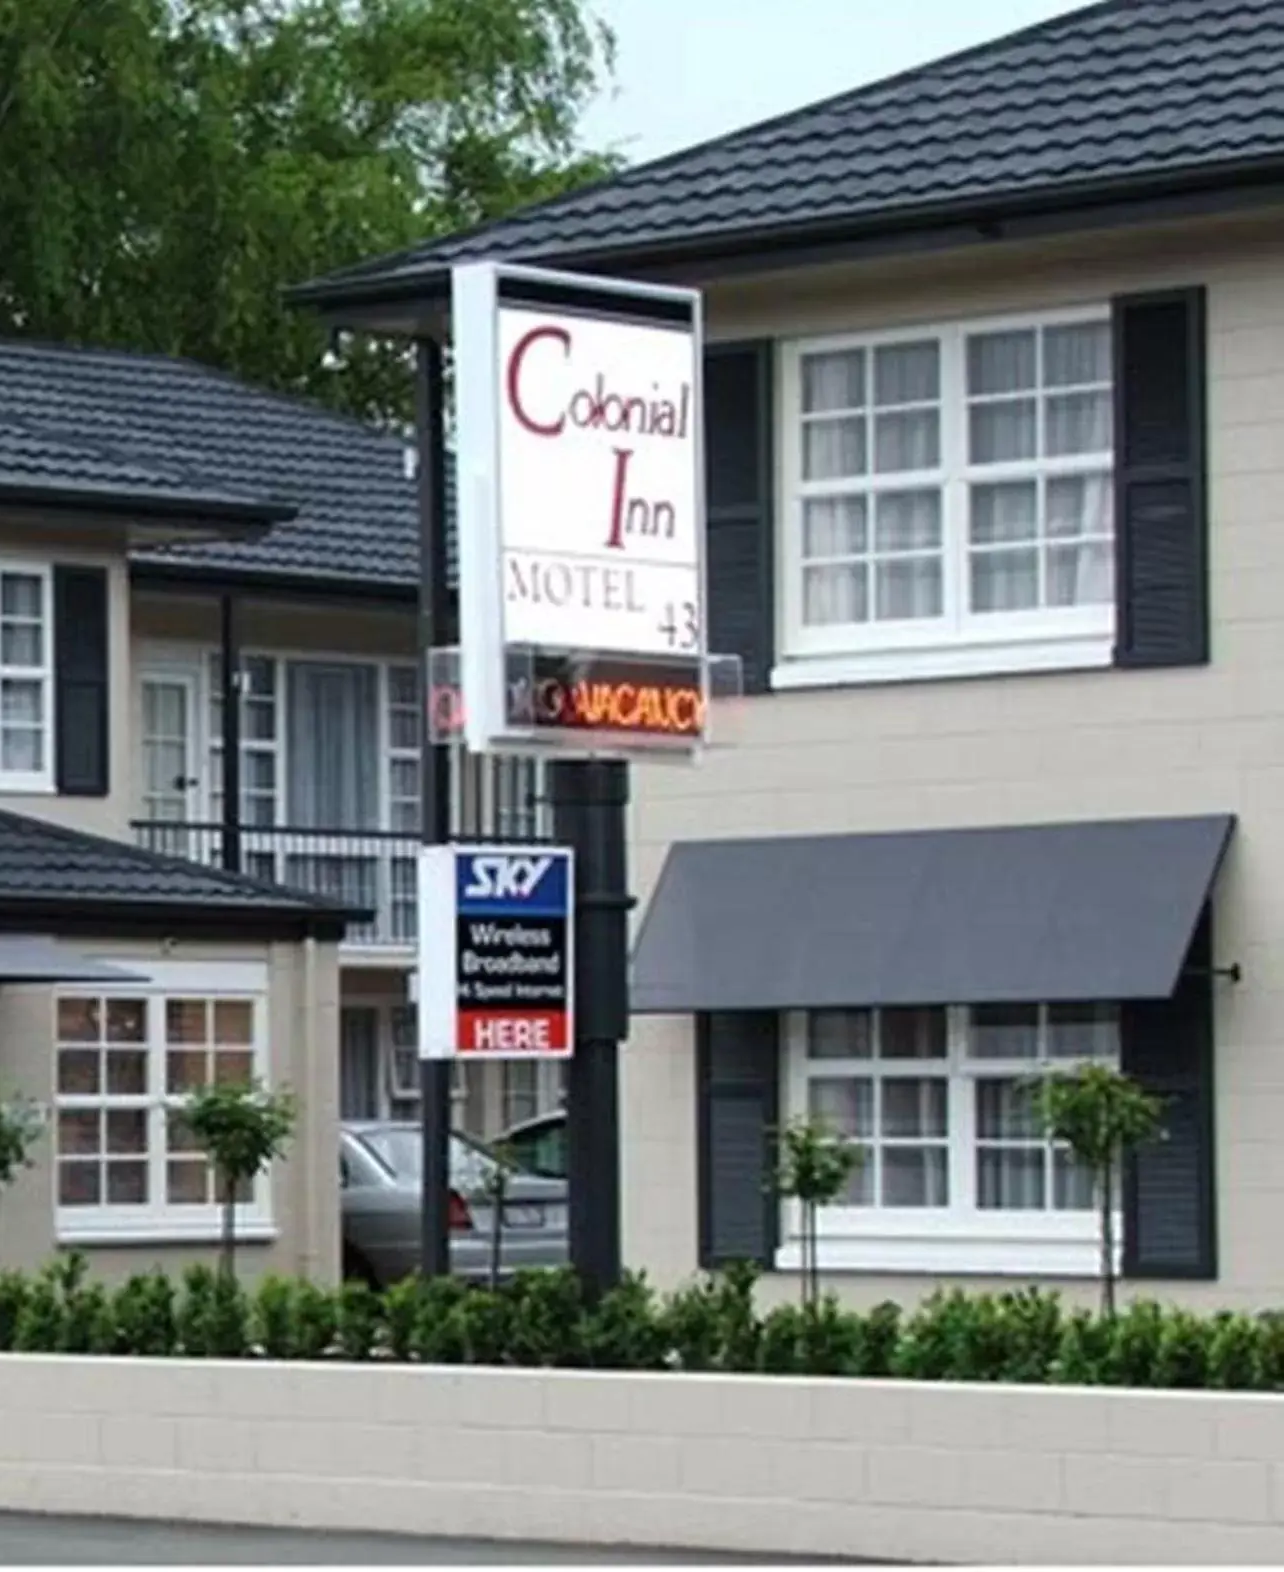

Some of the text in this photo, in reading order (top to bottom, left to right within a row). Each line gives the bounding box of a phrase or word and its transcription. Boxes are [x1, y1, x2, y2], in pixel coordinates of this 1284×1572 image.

[507, 325, 690, 439] Colonial
[605, 448, 676, 549] Inn
[507, 560, 646, 612] MOTEL
[657, 603, 699, 650] 43
[465, 856, 553, 899] SKY
[462, 949, 561, 975] Broadband
[474, 1019, 551, 1050] HERE
